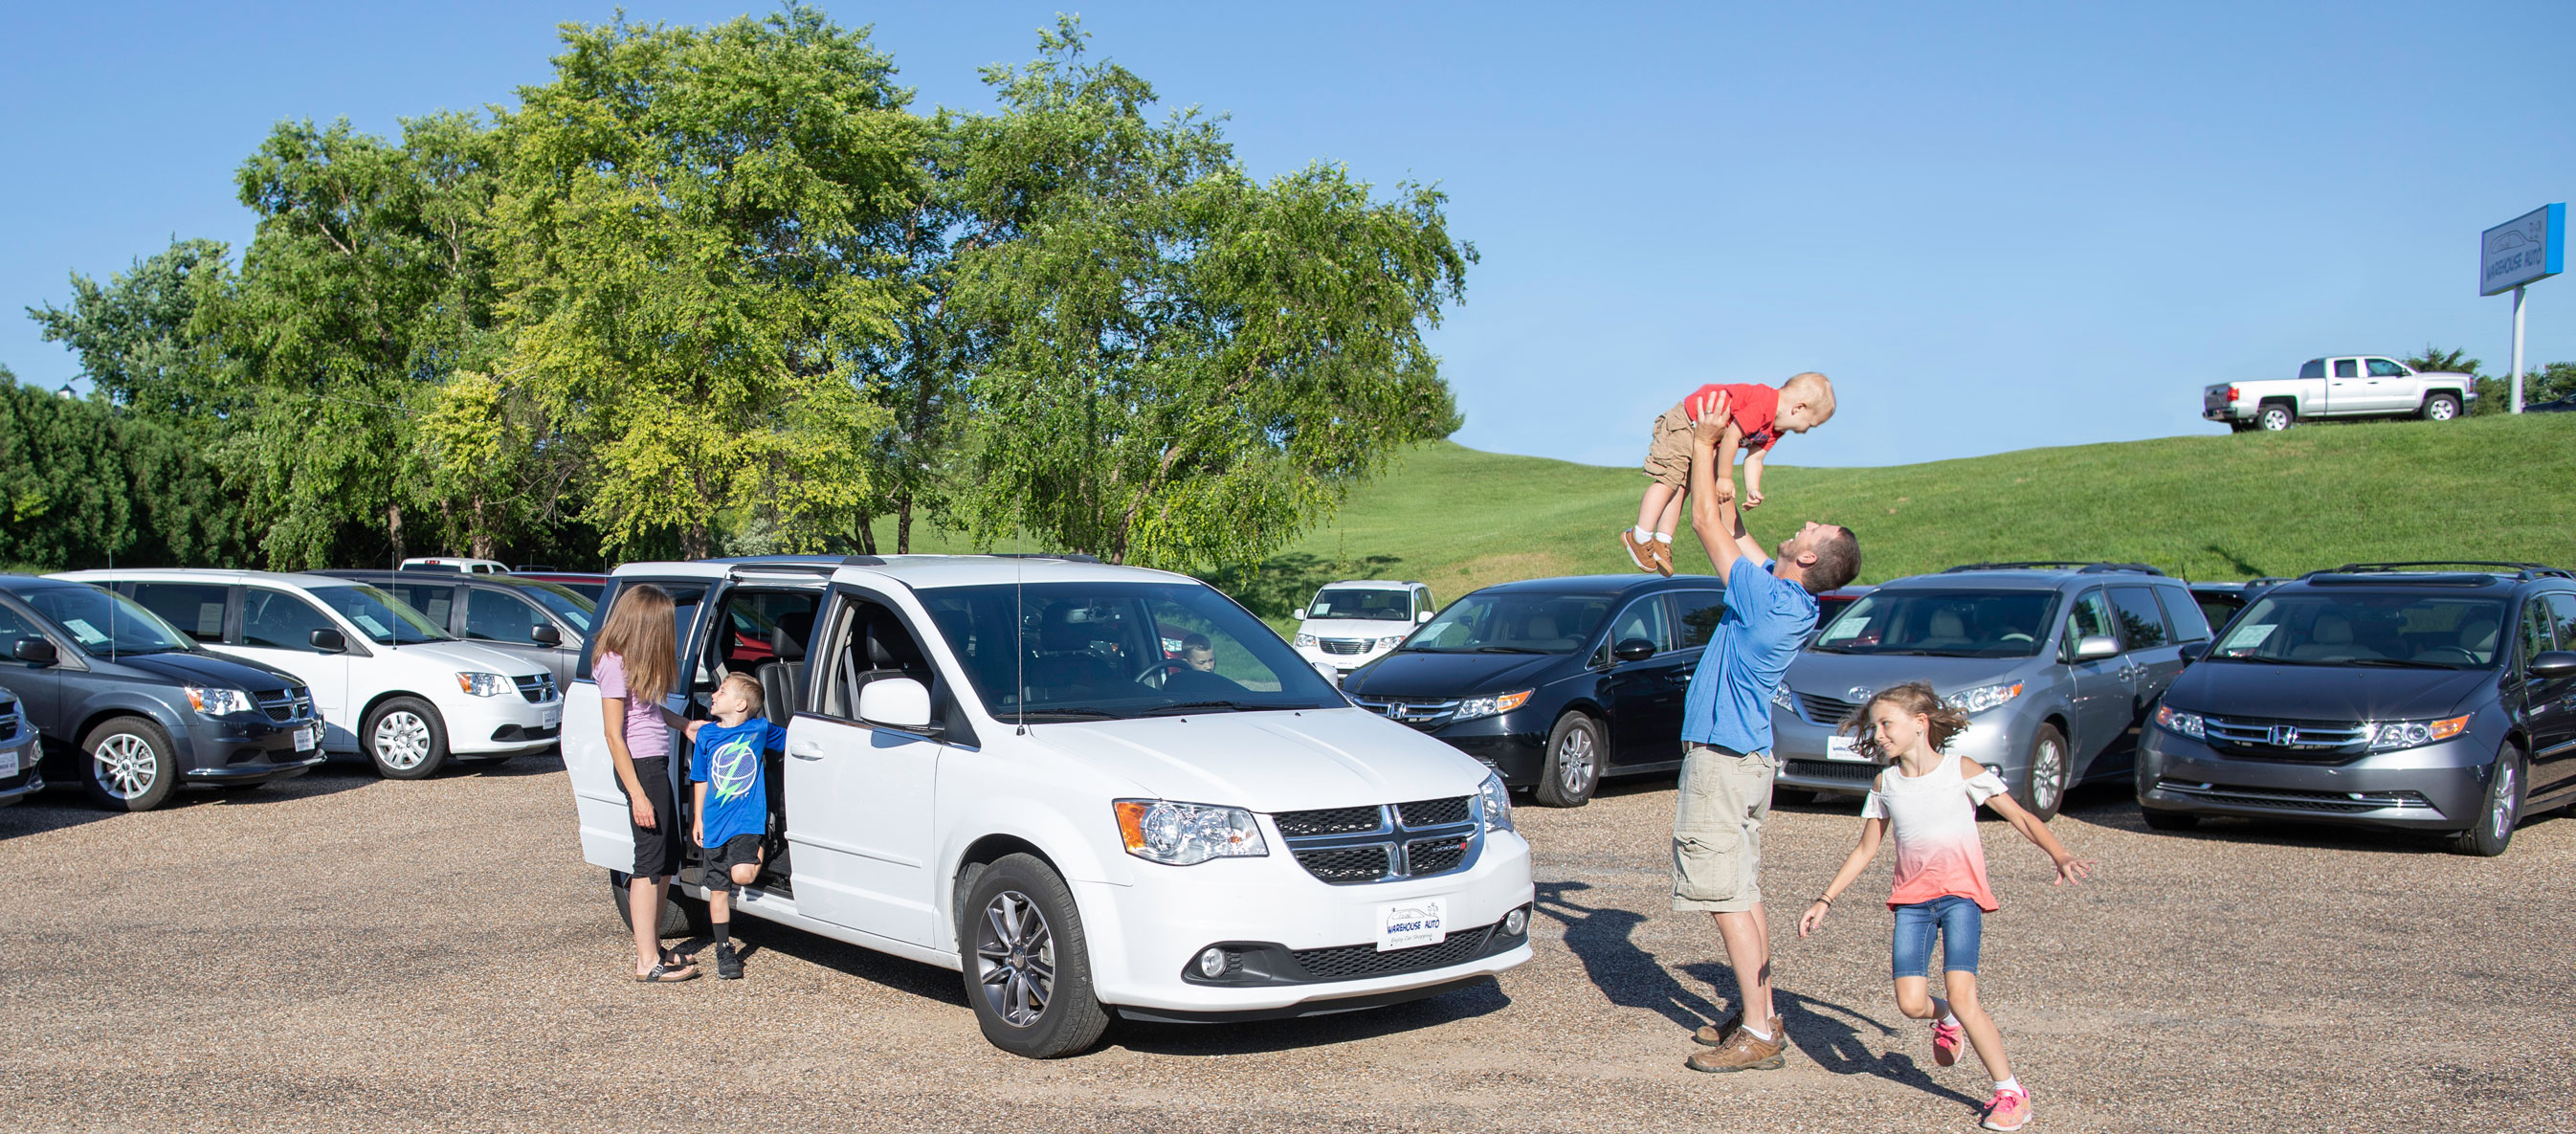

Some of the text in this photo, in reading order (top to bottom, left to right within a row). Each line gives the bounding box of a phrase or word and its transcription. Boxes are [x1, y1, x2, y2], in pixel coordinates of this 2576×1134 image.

[2486, 248, 2542, 281] WAREHOUSE AUTO
[1388, 919, 1440, 934] WAREHOUSE AUTO
